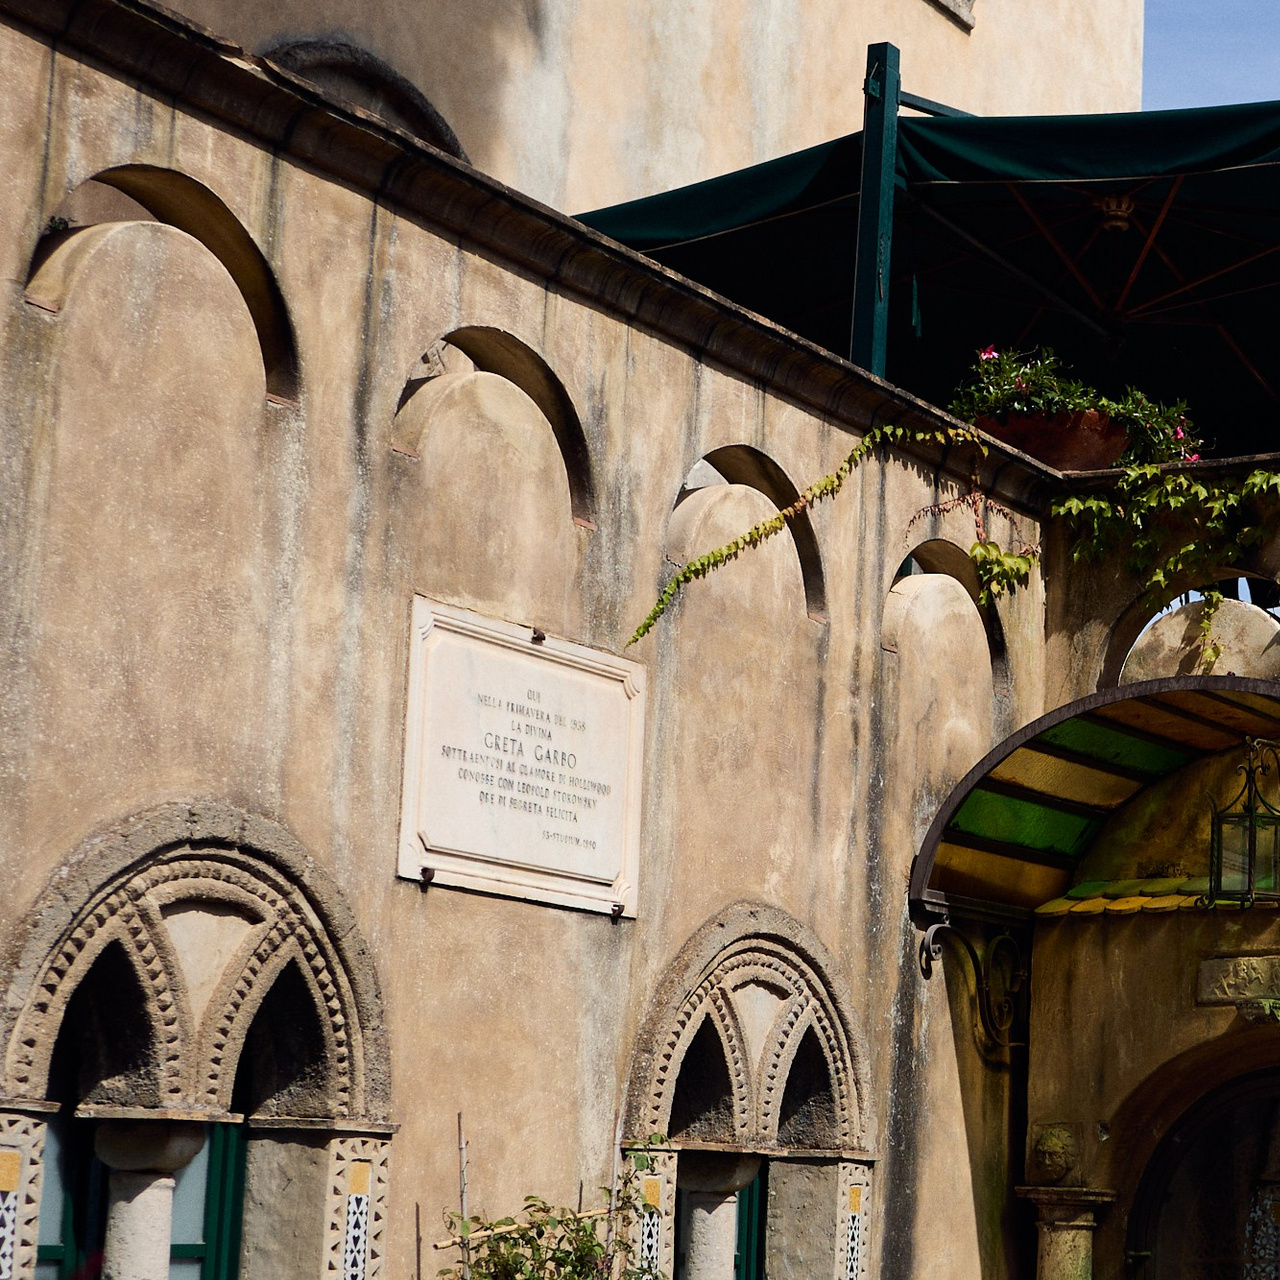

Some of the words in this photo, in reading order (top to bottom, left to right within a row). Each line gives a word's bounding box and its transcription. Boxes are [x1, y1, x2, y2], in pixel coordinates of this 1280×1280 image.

[477, 693, 502, 709] NELLA
[506, 701, 551, 724] PRIMAVERA
[511, 720, 522, 733] LA
[525, 724, 552, 741] DIVINA
[484, 732, 524, 757] GRETA
[534, 745, 577, 769] GARBO
[506, 760, 516, 773] AL
[498, 777, 514, 791] CON
